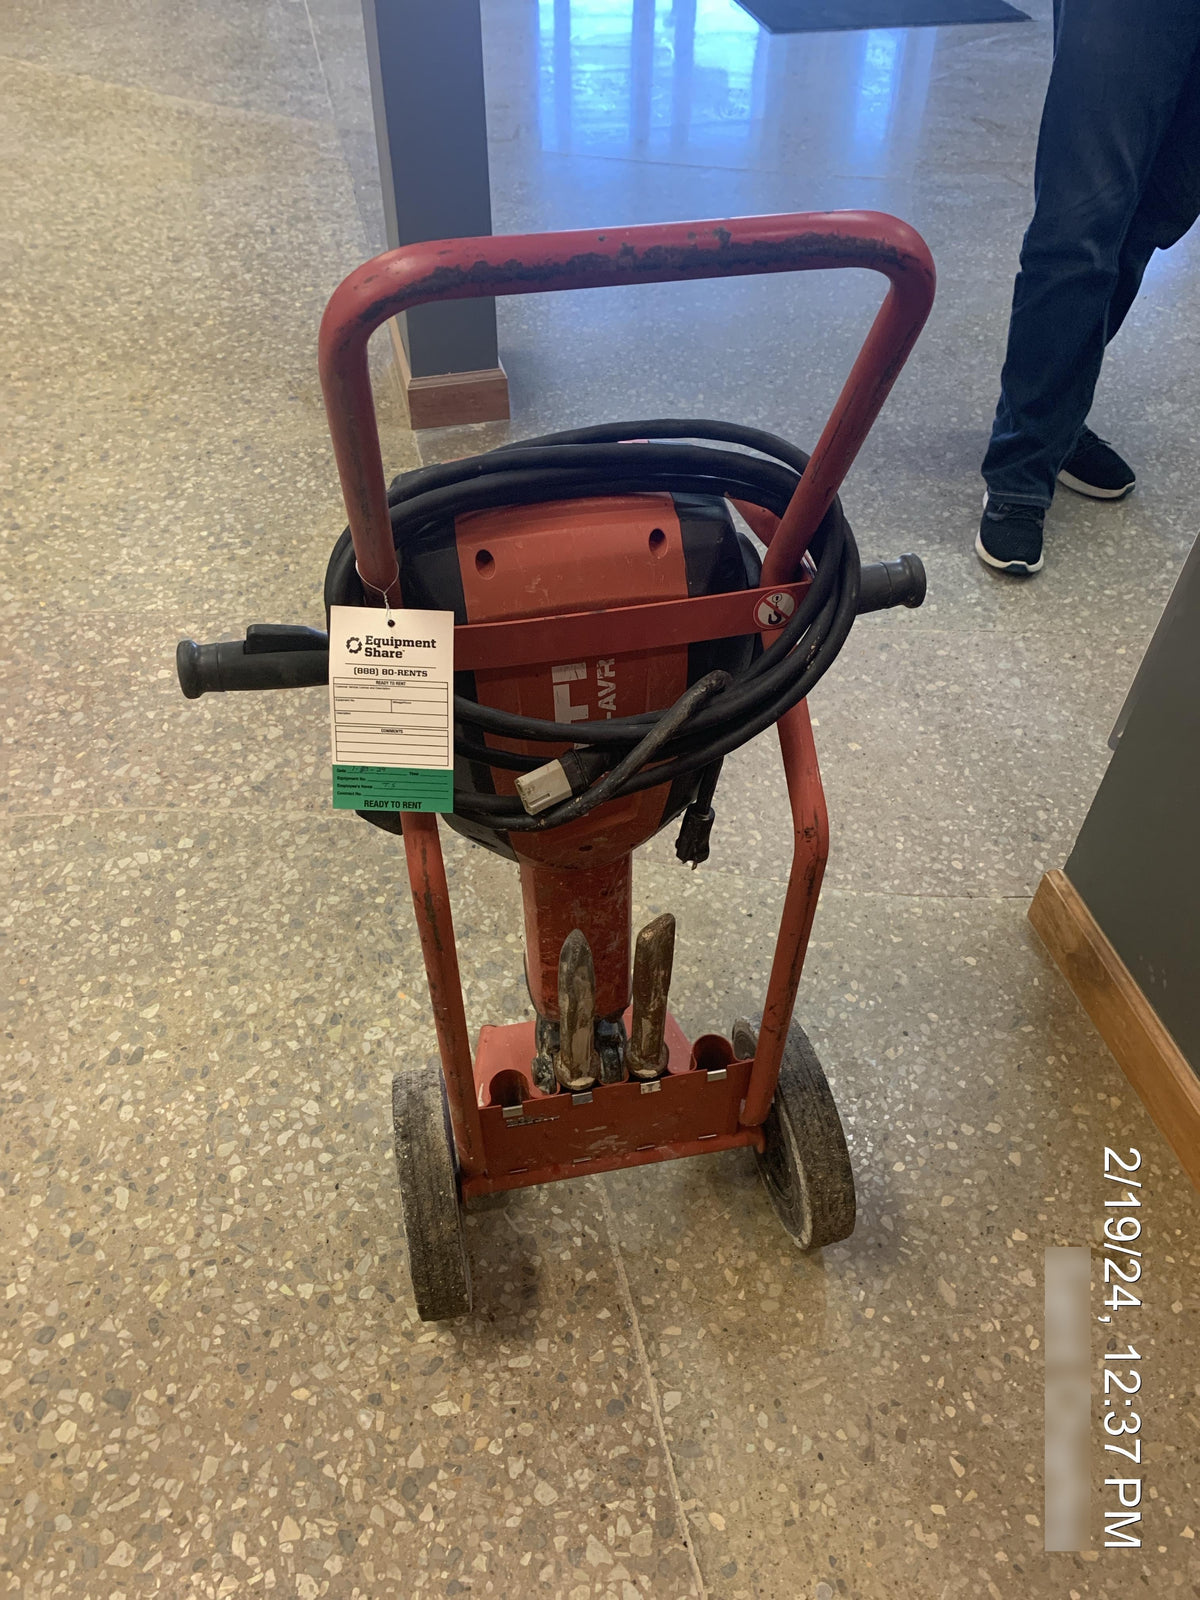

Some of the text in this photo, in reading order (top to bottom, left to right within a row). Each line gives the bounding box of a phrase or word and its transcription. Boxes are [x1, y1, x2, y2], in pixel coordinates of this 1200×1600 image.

[365, 635, 437, 649] Equipment
[364, 647, 403, 659] Share
[353, 666, 428, 677] (888) 80-RENTS
[364, 799, 389, 808] READY
[402, 801, 423, 810] RENT
